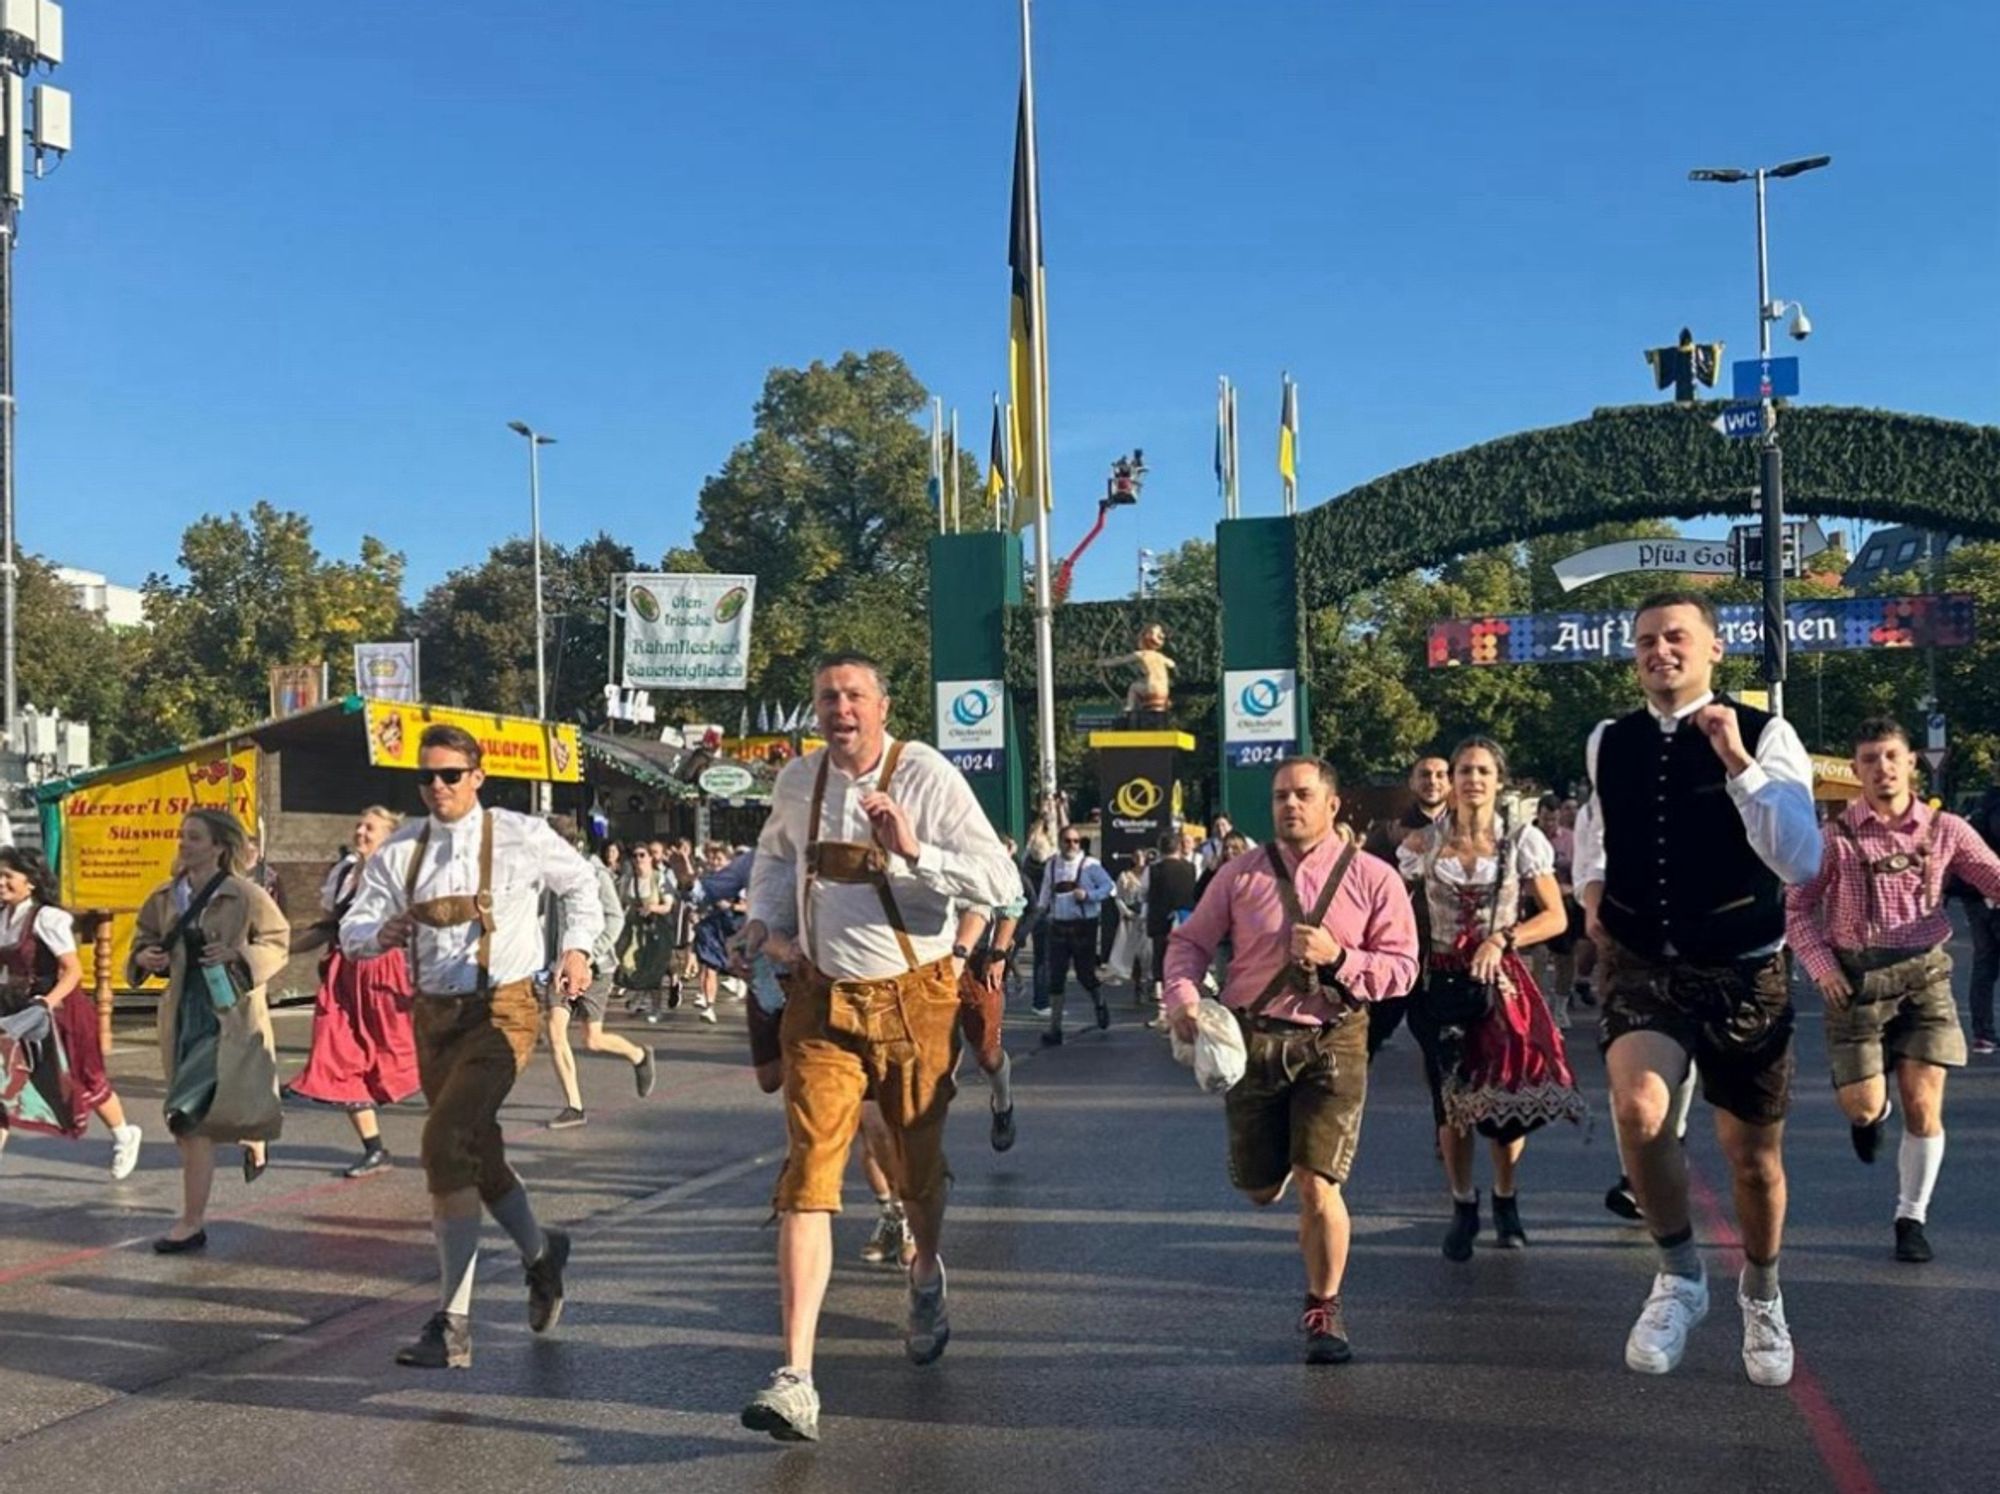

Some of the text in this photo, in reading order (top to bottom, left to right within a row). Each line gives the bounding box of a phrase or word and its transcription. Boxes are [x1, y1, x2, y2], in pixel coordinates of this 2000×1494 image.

[1726, 410, 1757, 431] WC
[1638, 543, 1687, 567] Pfüa
[1550, 619, 1617, 657] Auf
[1240, 745, 1285, 764] 2024
